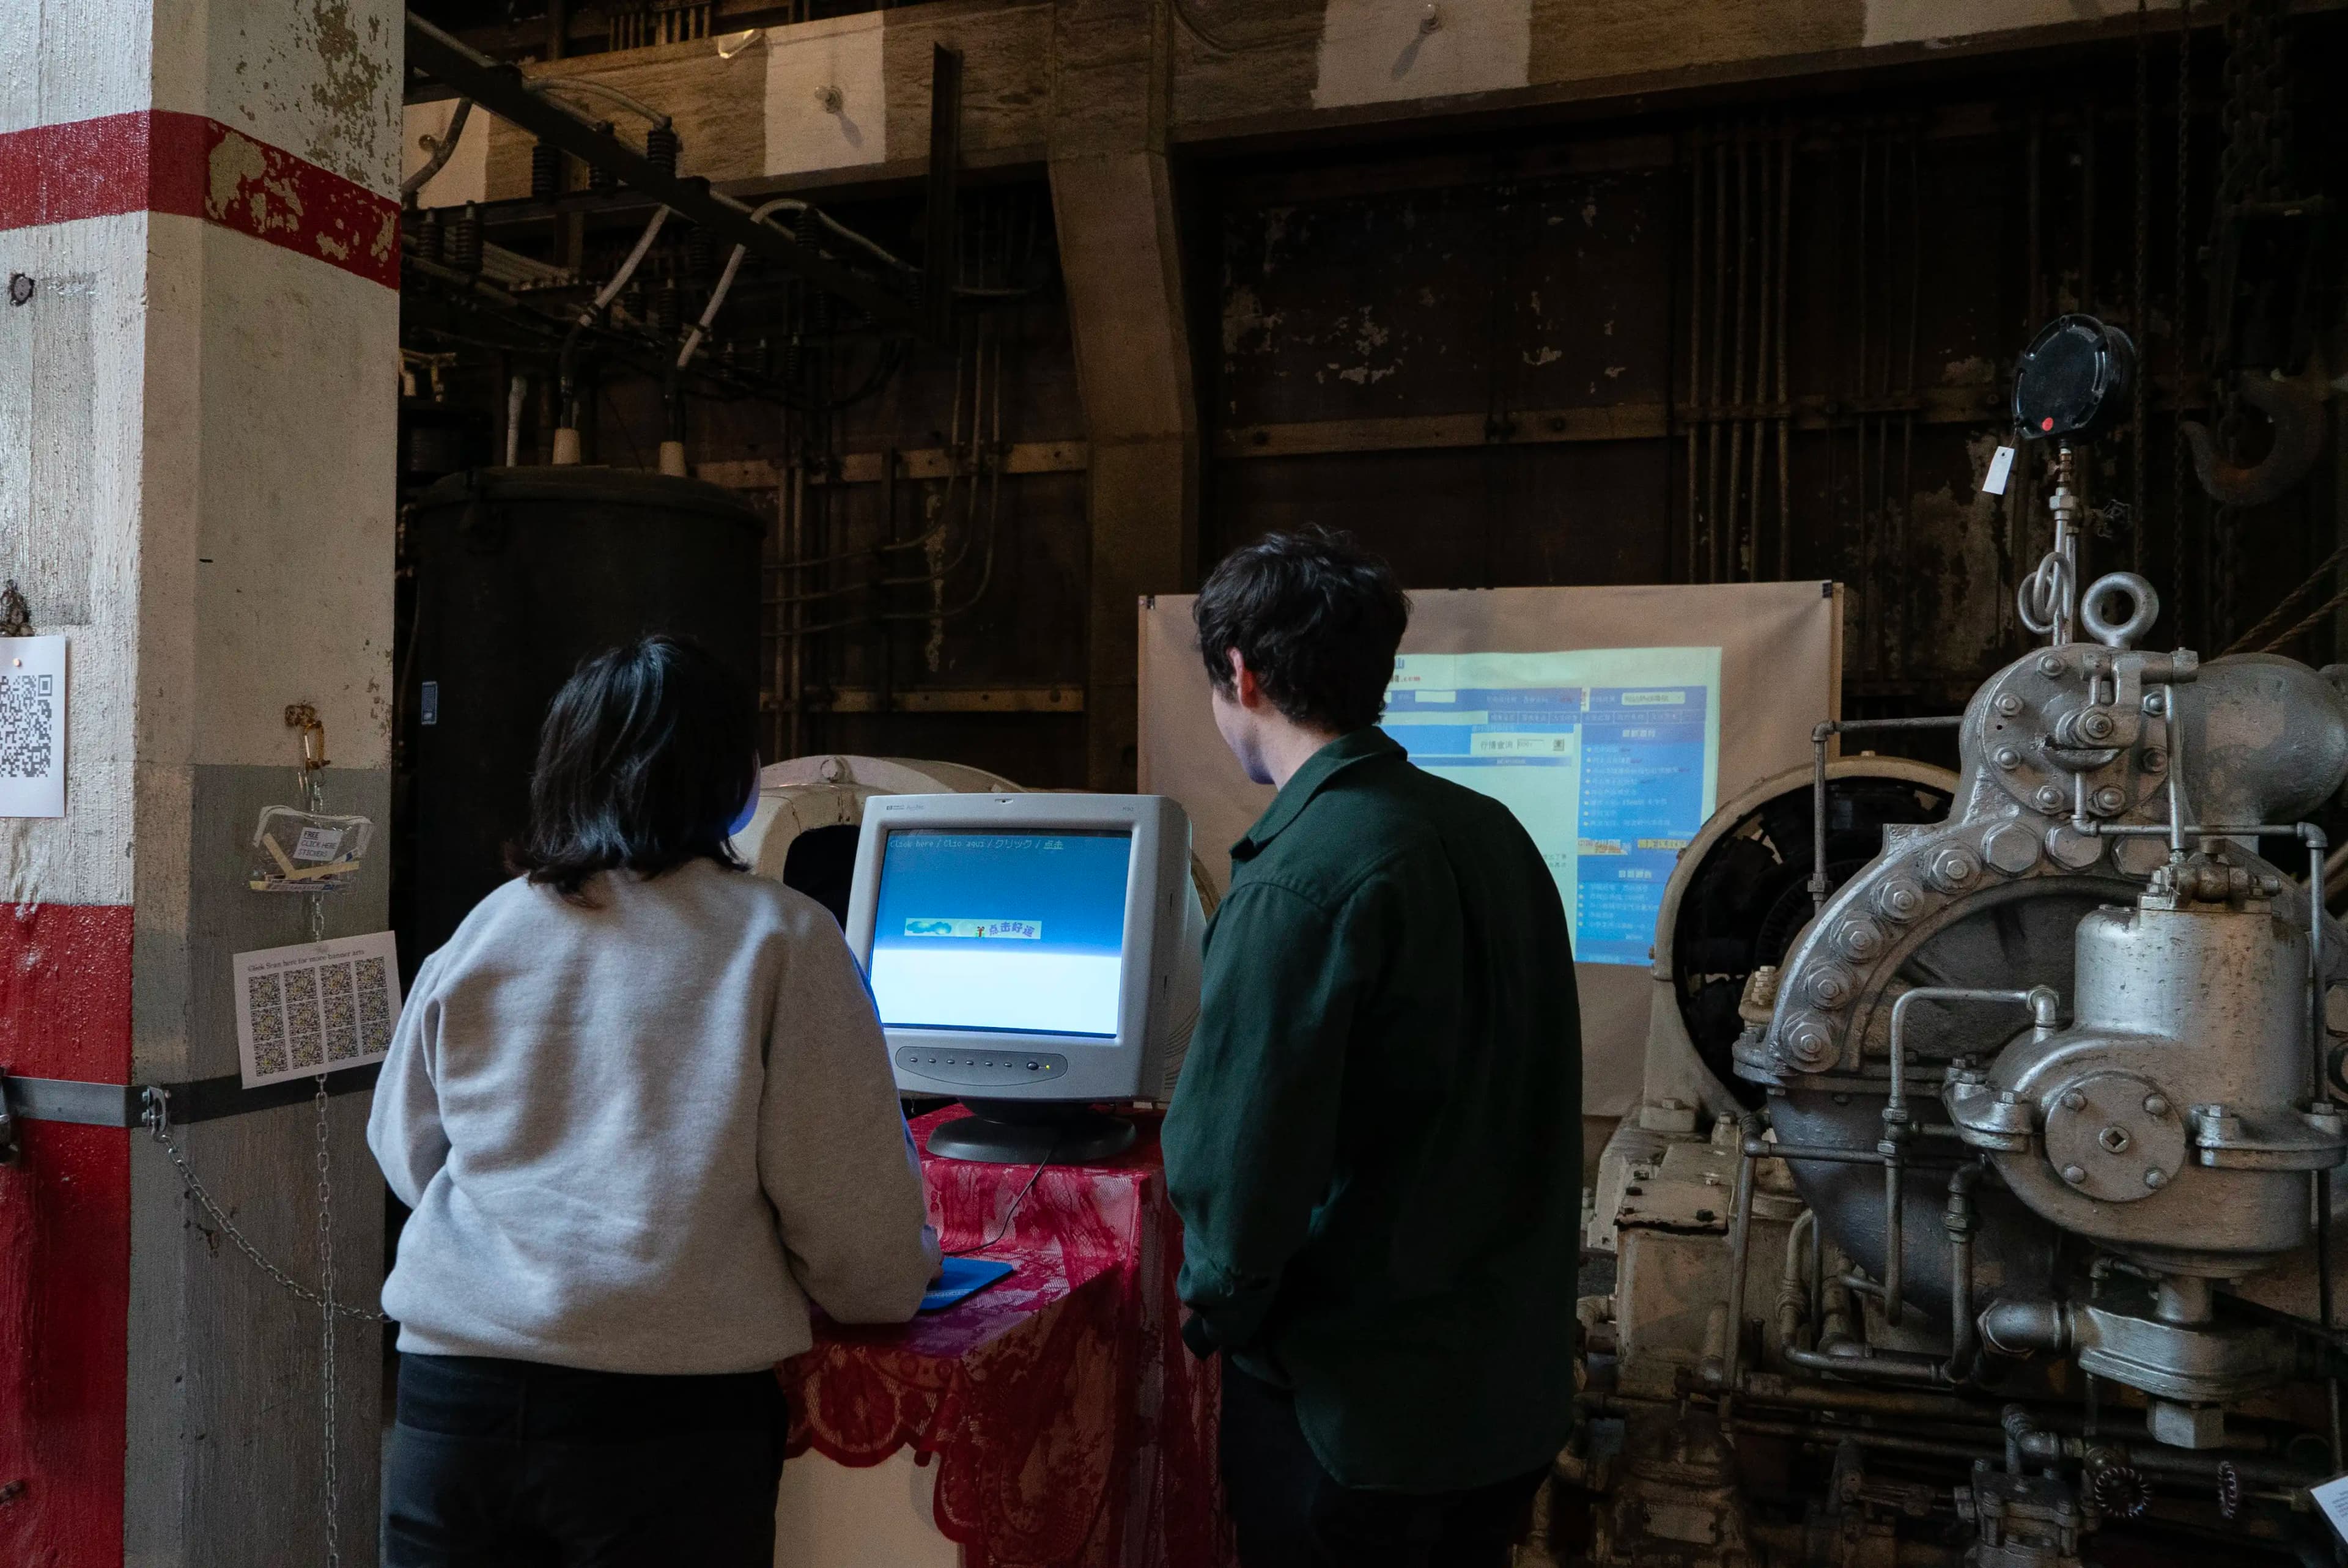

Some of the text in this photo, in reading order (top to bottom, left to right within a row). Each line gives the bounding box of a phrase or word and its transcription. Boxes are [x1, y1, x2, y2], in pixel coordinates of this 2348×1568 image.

[301, 840, 322, 848] CLICK
[989, 921, 1035, 937] 点击好运
